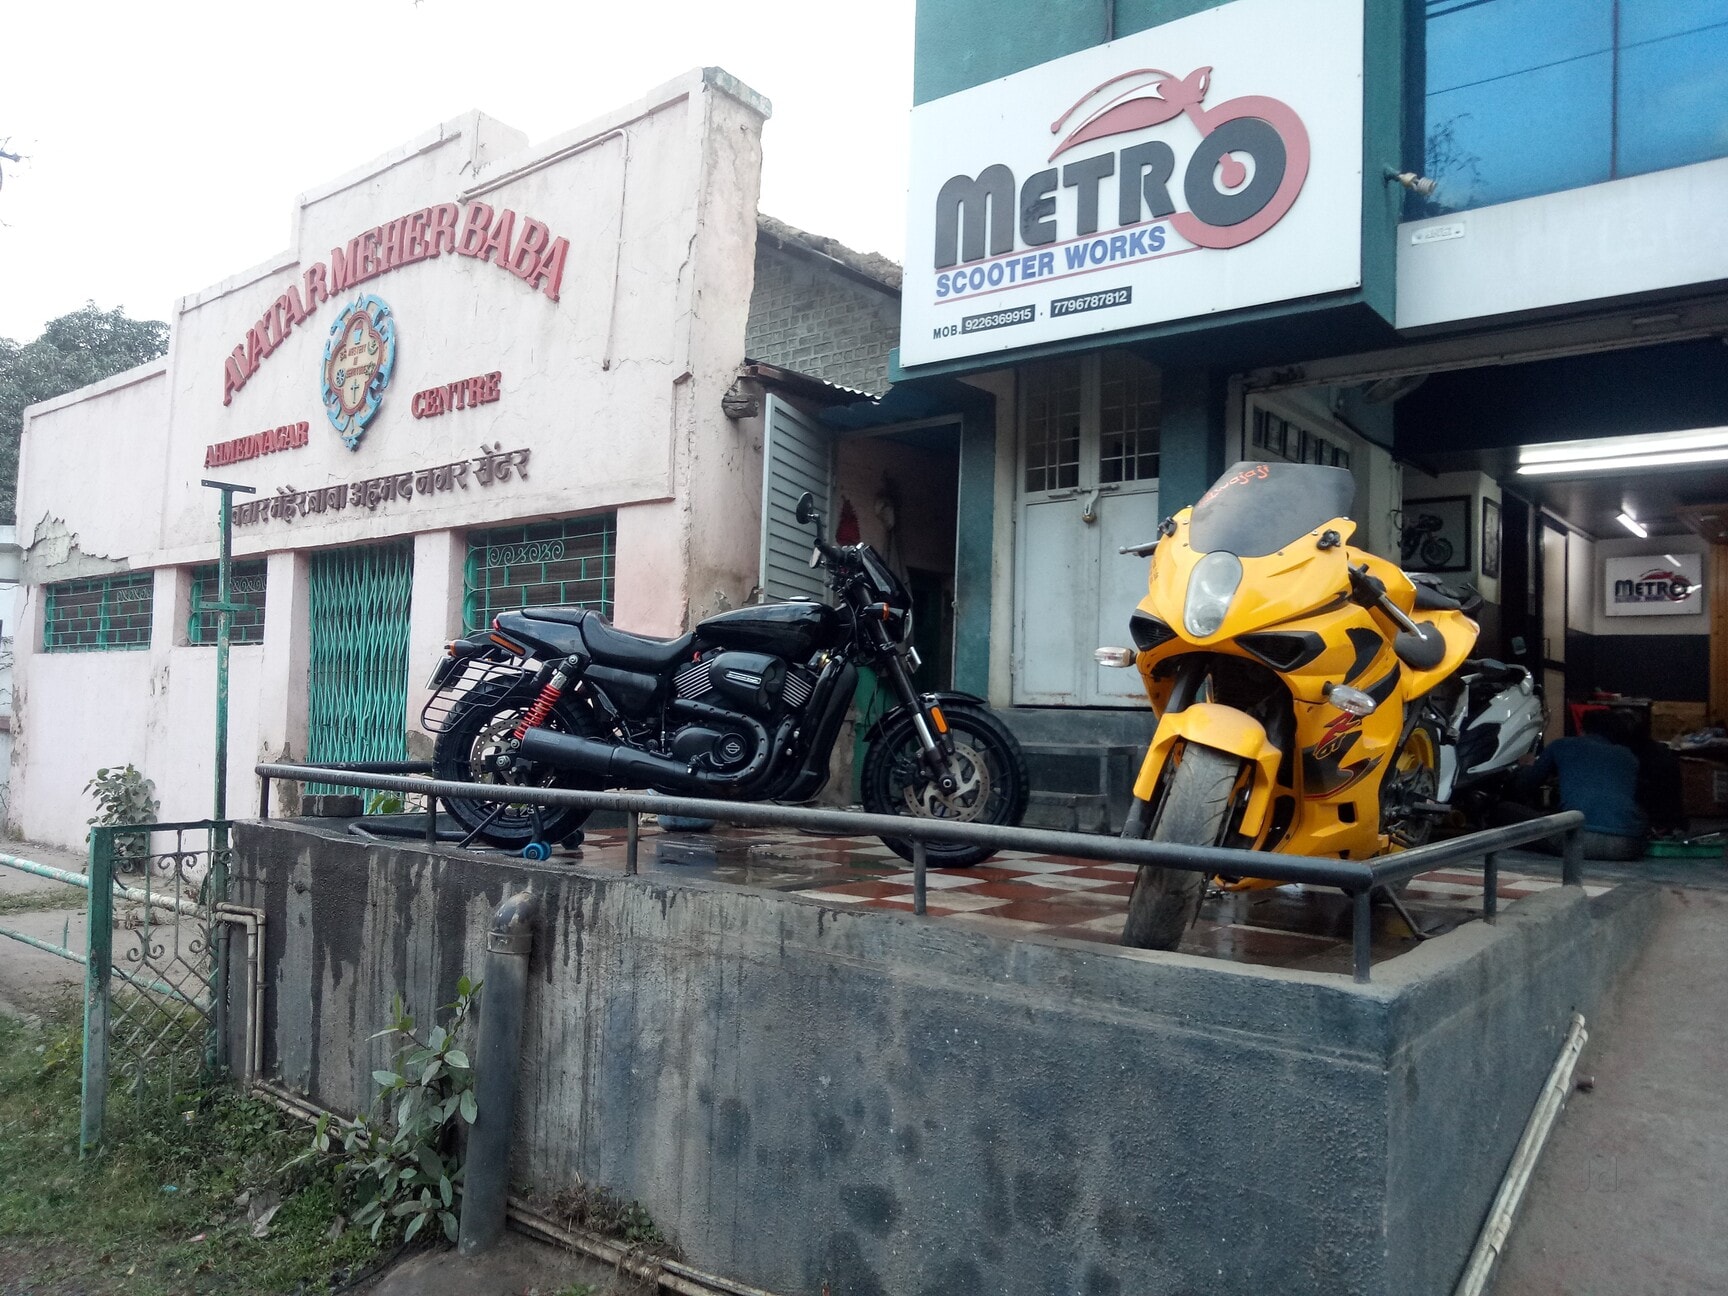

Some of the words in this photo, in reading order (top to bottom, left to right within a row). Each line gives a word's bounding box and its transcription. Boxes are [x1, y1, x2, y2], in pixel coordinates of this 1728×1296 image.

[935, 116, 1287, 270] METRO
[936, 252, 1055, 297] SCOOTER
[1065, 225, 1166, 270] WORKS
[223, 262, 329, 406] AVATAR
[329, 201, 459, 297] MEHER
[455, 201, 570, 302] BABA
[933, 324, 962, 339] MOB.
[965, 308, 1032, 331] 9226369915
[1053, 290, 1128, 314] 7796787812
[204, 421, 310, 468] AHMEDNAGAR
[411, 371, 502, 419] CENTRE
[1615, 579, 1688, 597] METRO
